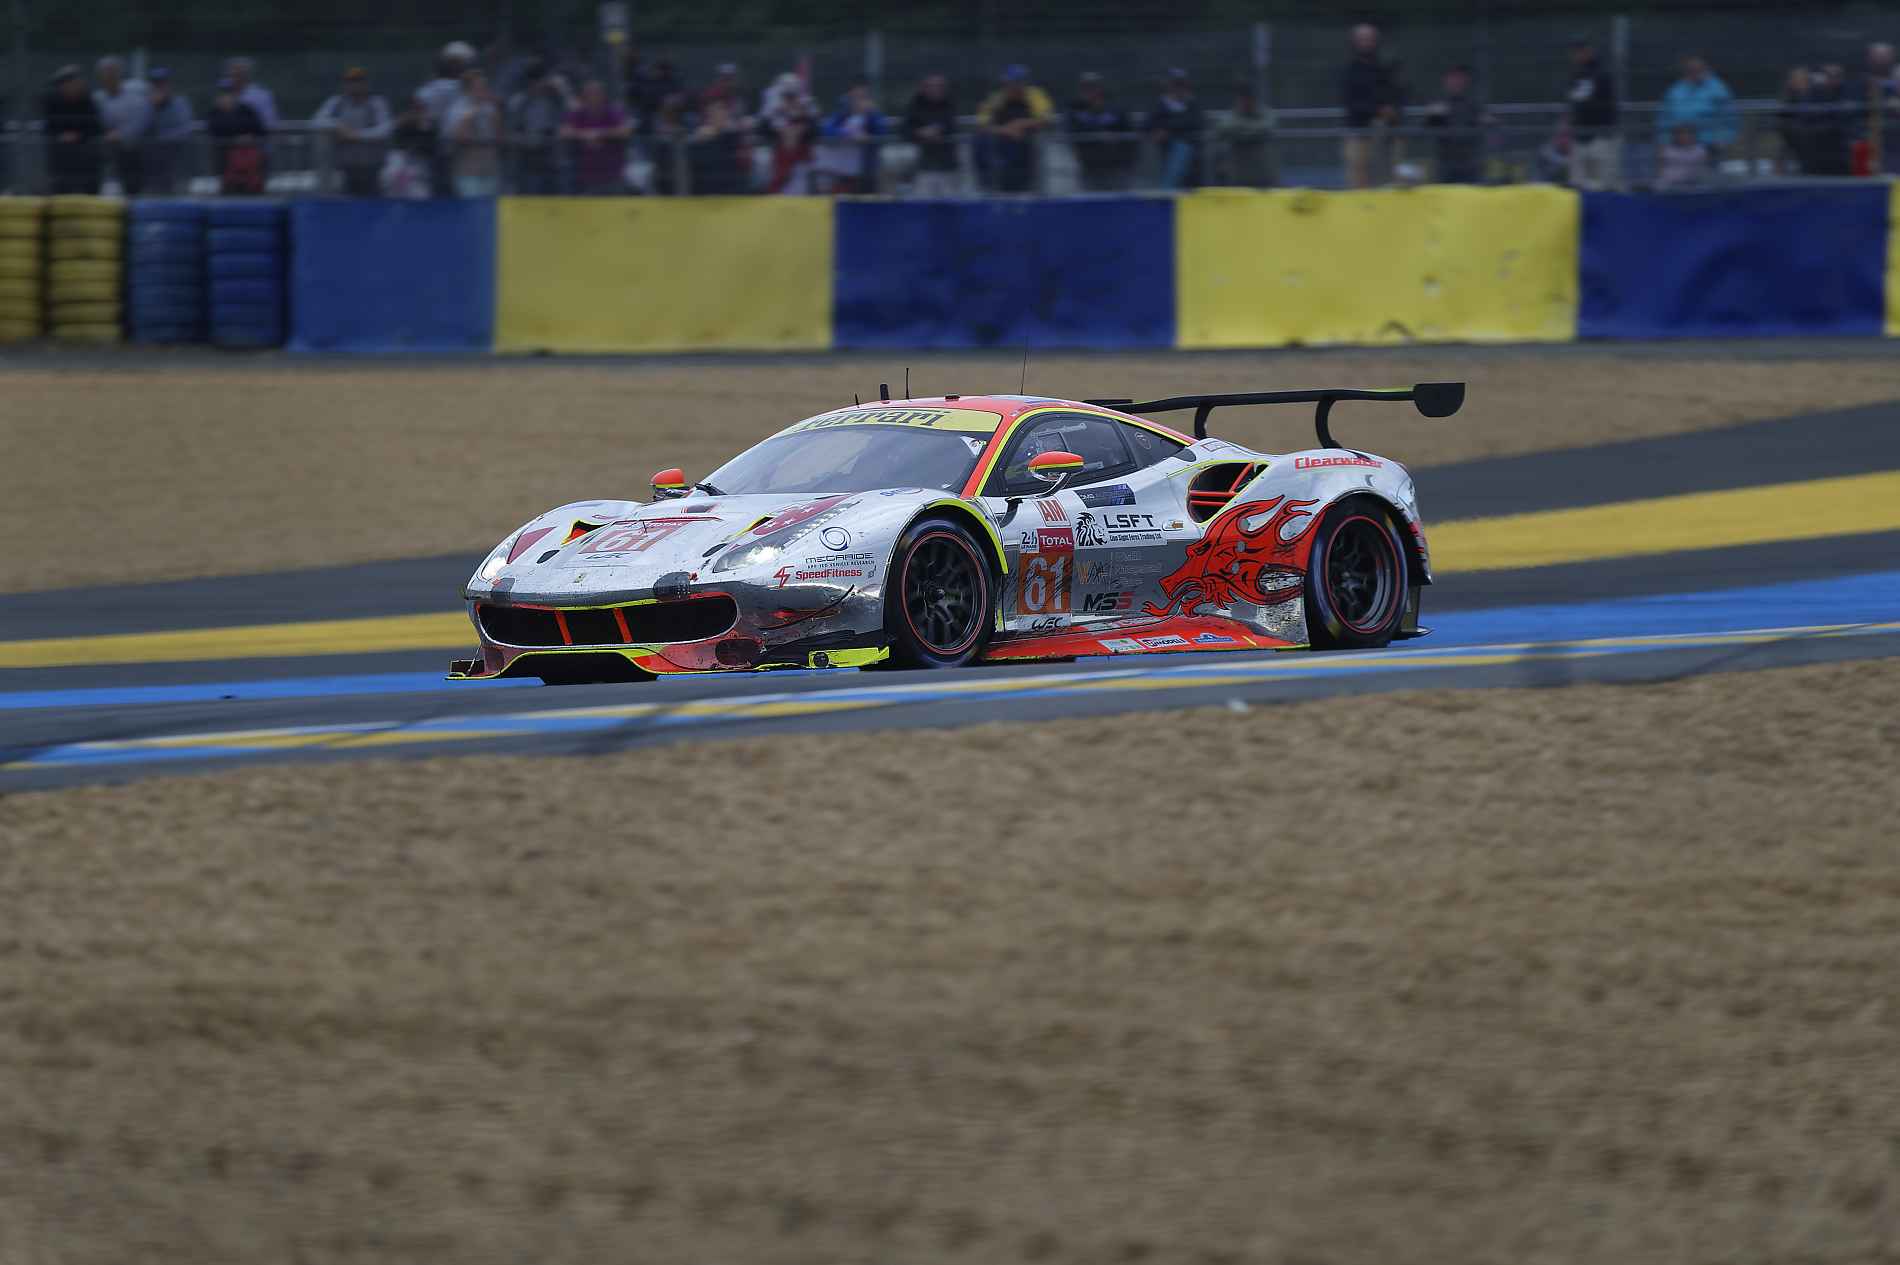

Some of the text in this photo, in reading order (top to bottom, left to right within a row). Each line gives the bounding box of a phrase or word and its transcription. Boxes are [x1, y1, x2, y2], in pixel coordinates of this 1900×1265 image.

[1039, 499, 1067, 521] AM
[1103, 514, 1154, 528] LSFT
[1040, 535, 1072, 546] TOTAL
[795, 568, 863, 581] SpeedFitness
[1024, 556, 1066, 611] 61
[1031, 616, 1064, 629] WEC
